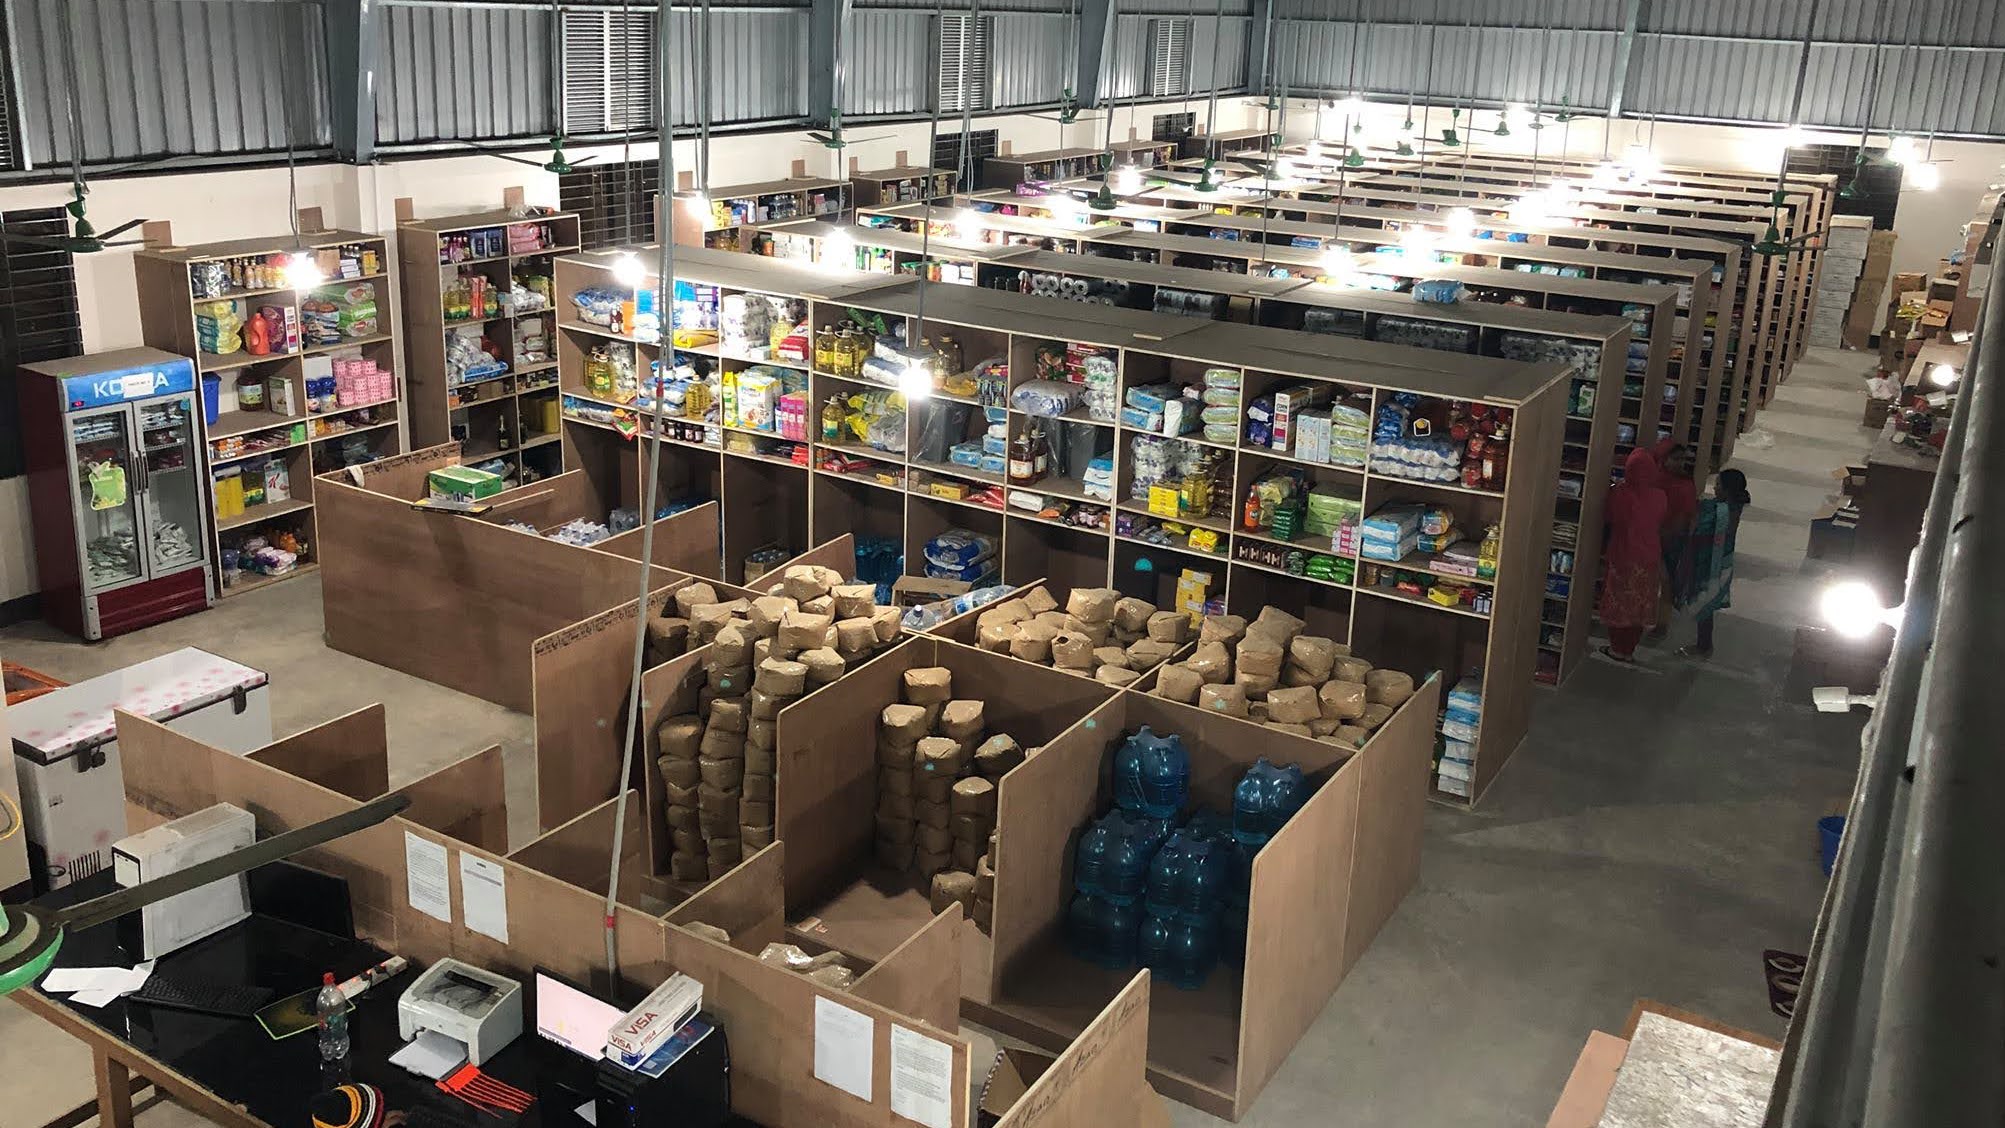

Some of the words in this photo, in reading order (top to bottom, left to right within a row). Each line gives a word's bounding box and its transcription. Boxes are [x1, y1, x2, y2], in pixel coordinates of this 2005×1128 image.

[93, 371, 170, 399] KOA
[624, 1012, 658, 1035] VISA
[611, 1034, 633, 1051] VISA
